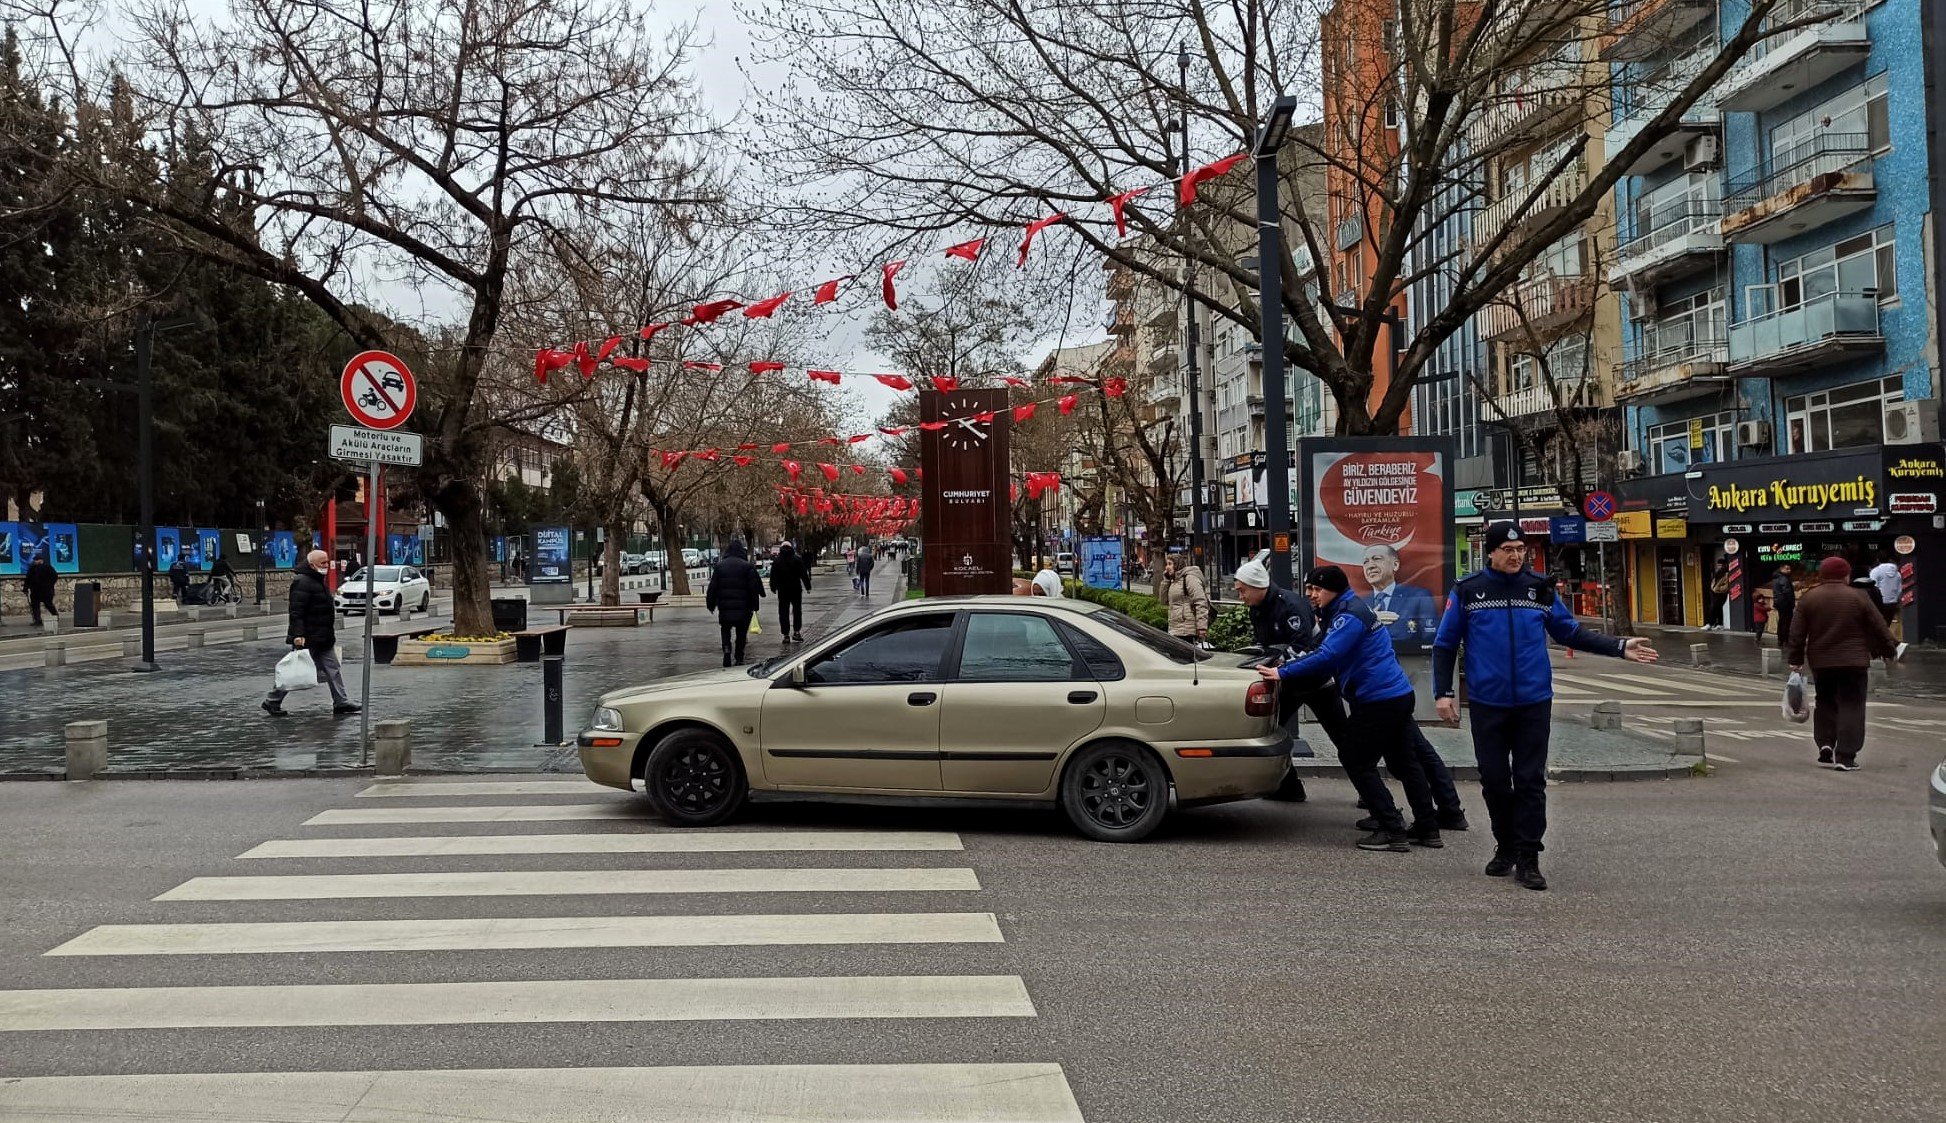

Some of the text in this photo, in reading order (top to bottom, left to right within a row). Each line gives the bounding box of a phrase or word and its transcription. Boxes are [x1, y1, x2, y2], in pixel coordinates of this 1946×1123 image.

[353, 430, 388, 441] Motorlu
[342, 439, 411, 453] Akülü Araçların
[336, 448, 372, 459] Girmesi
[1368, 461, 1417, 475] BERABERİZ
[1899, 459, 1937, 470] Ankara
[1888, 466, 1945, 478] Kuruyemiş
[1344, 485, 1418, 505] GÜVENDEYİZ
[1707, 483, 1768, 512] Ankara
[1770, 475, 1875, 510] Kuruyemiş
